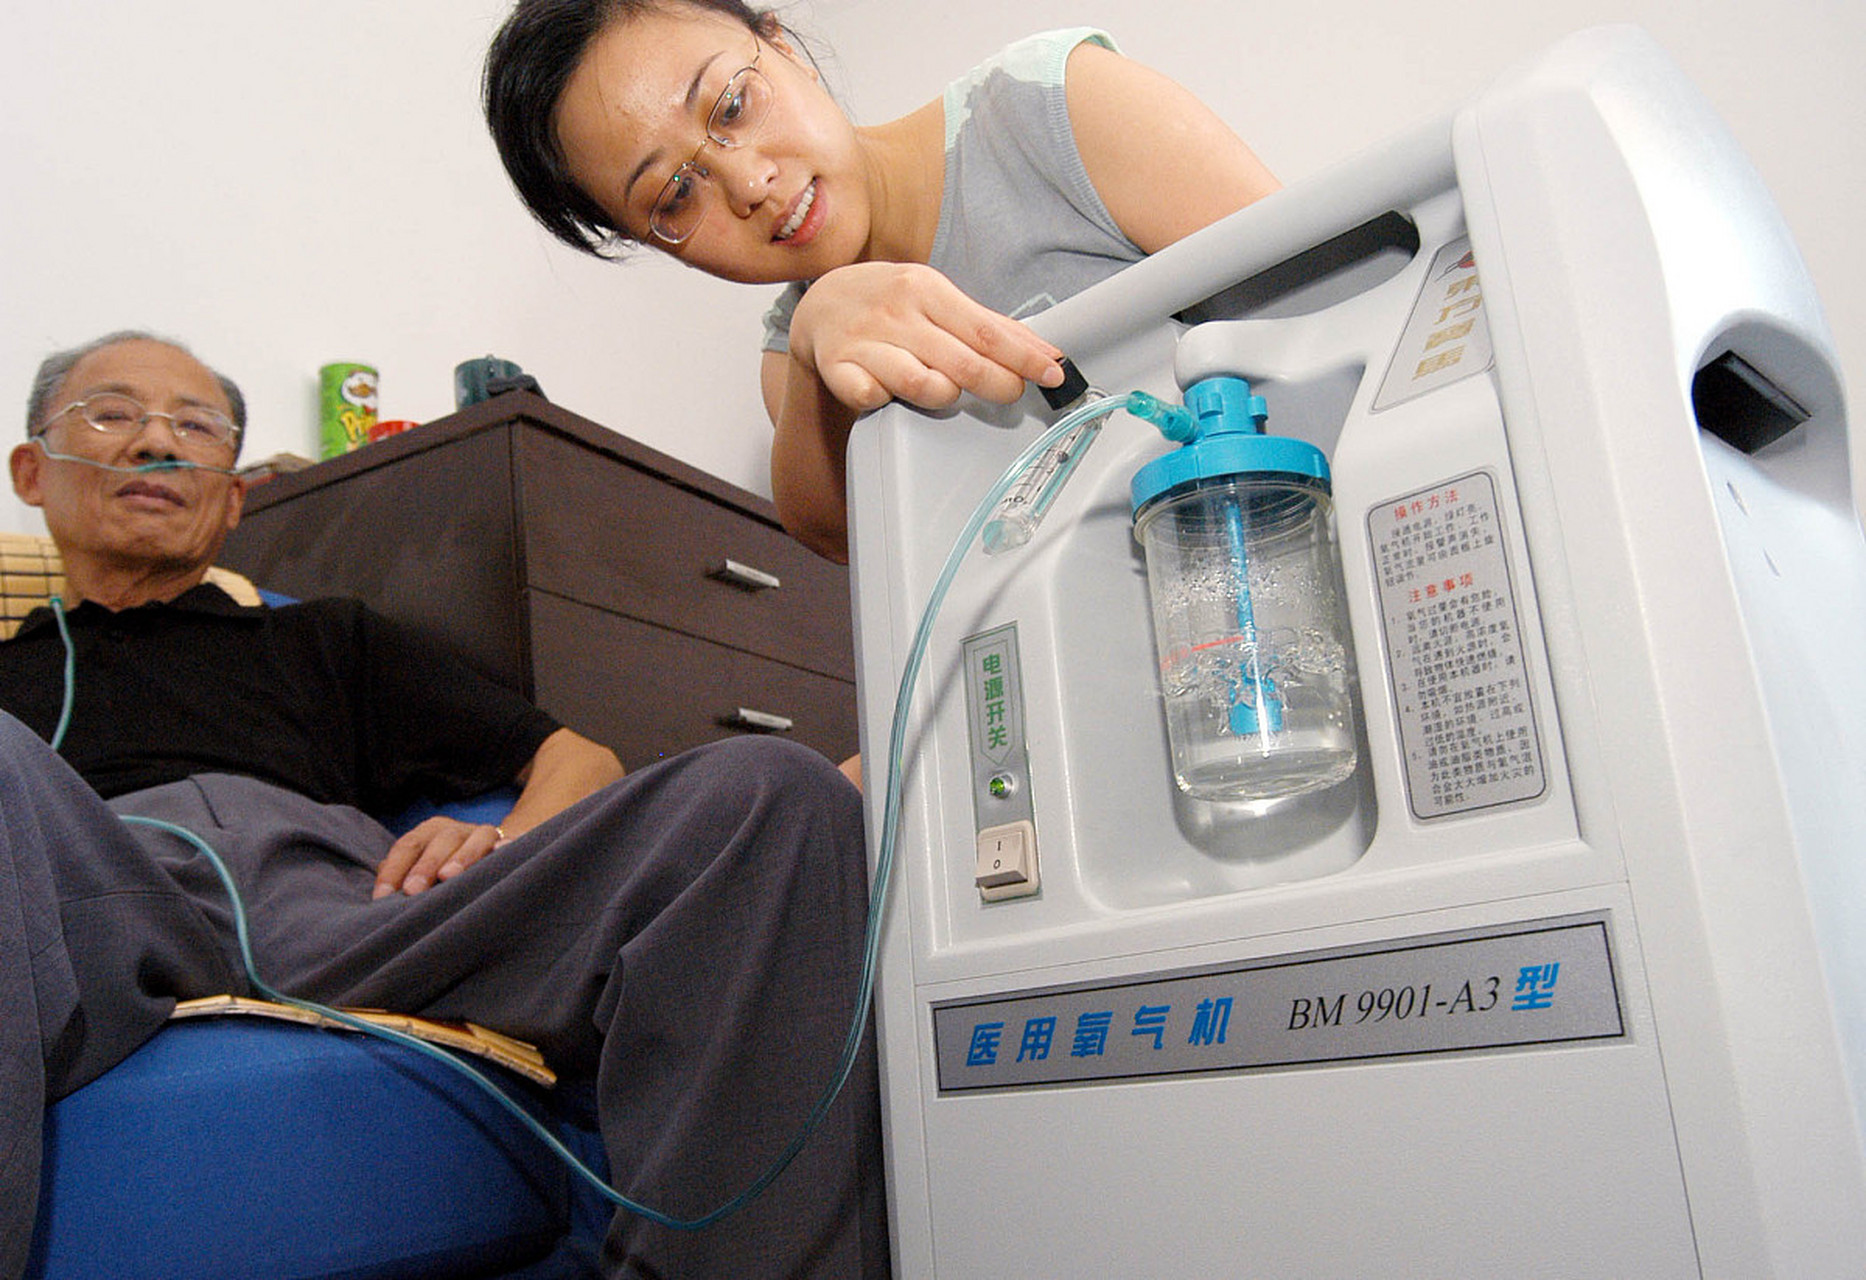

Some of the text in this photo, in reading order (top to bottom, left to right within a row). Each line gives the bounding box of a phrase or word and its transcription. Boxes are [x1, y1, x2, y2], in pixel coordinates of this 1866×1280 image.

[1393, 489, 1459, 521] 操作方法
[1408, 571, 1473, 603] 注意事项
[983, 653, 1008, 750] 电源开关
[966, 962, 1561, 1067] 医用氧气机 BM 9901-A3 型
